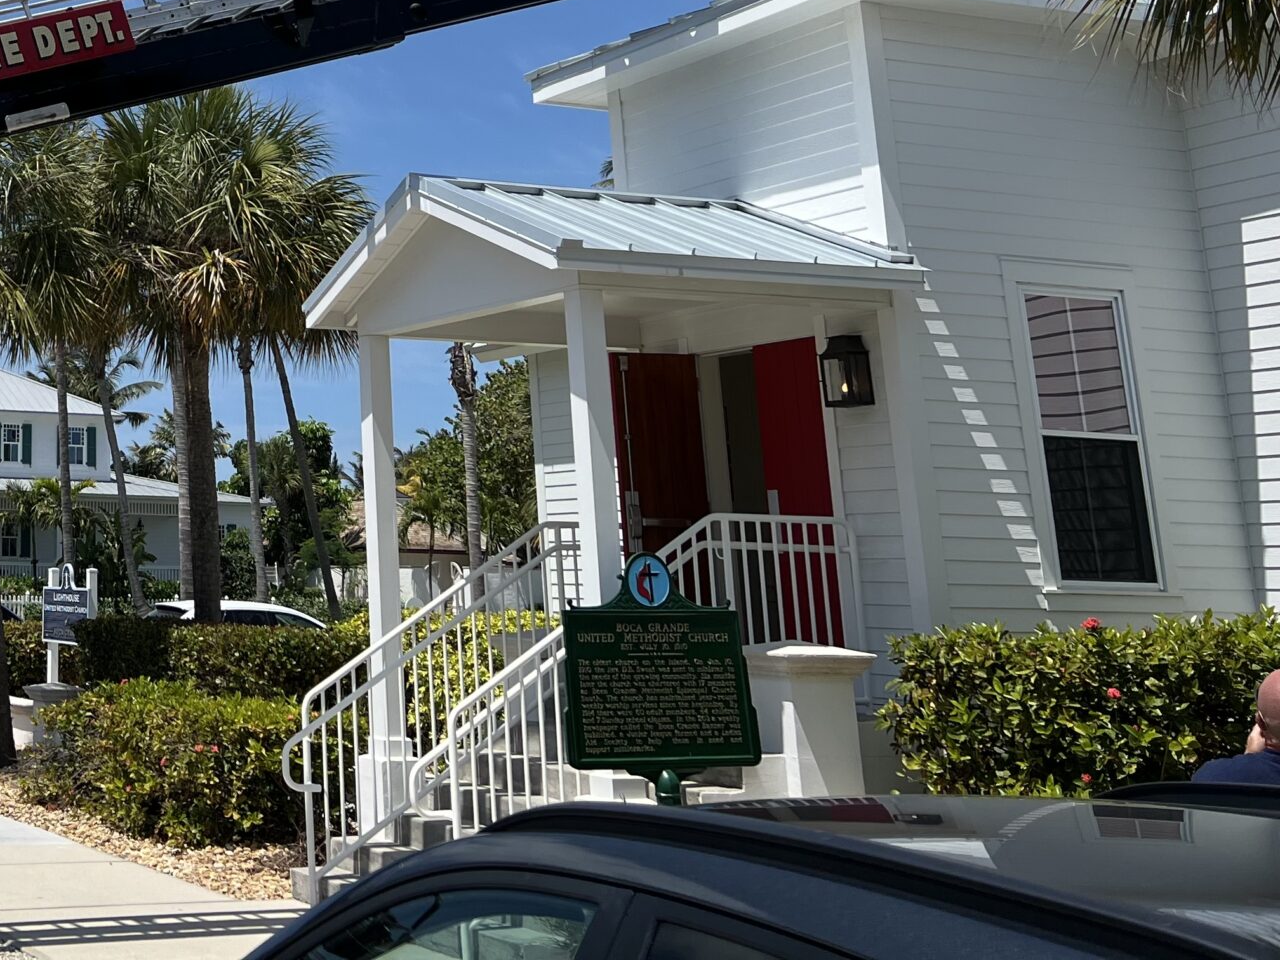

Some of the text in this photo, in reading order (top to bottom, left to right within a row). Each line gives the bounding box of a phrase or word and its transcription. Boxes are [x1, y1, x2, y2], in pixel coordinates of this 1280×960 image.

[32, 10, 125, 59] DEPT.
[53, 592, 80, 602] LIGHTHOUSE
[616, 623, 690, 632] BOCA GRANDE
[577, 633, 729, 643] UNITED METHODIST CHURCH
